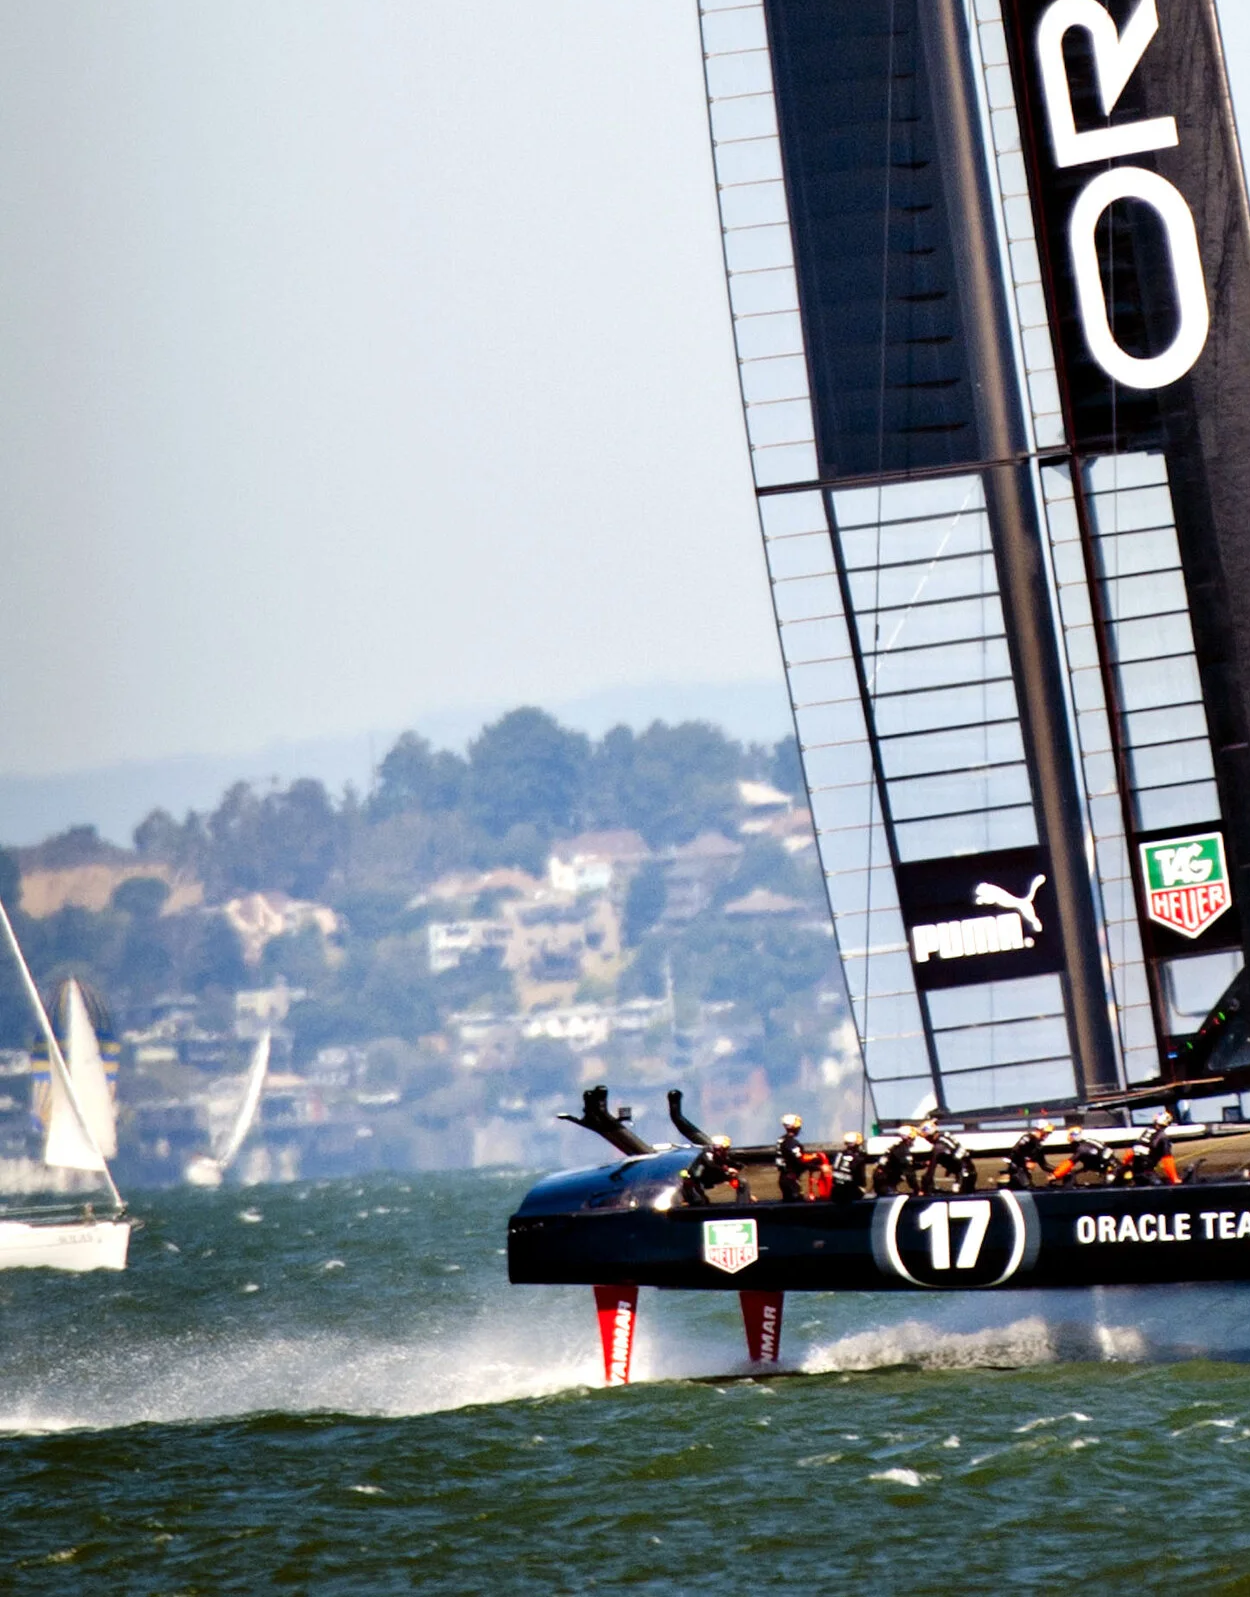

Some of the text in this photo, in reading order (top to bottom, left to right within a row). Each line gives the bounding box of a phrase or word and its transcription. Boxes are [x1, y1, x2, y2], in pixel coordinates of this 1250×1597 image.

[1154, 842, 1213, 886] TAG
[1152, 884, 1225, 930] HEUER
[918, 1200, 991, 1270] 17
[1076, 1215, 1192, 1244] ORACLE
